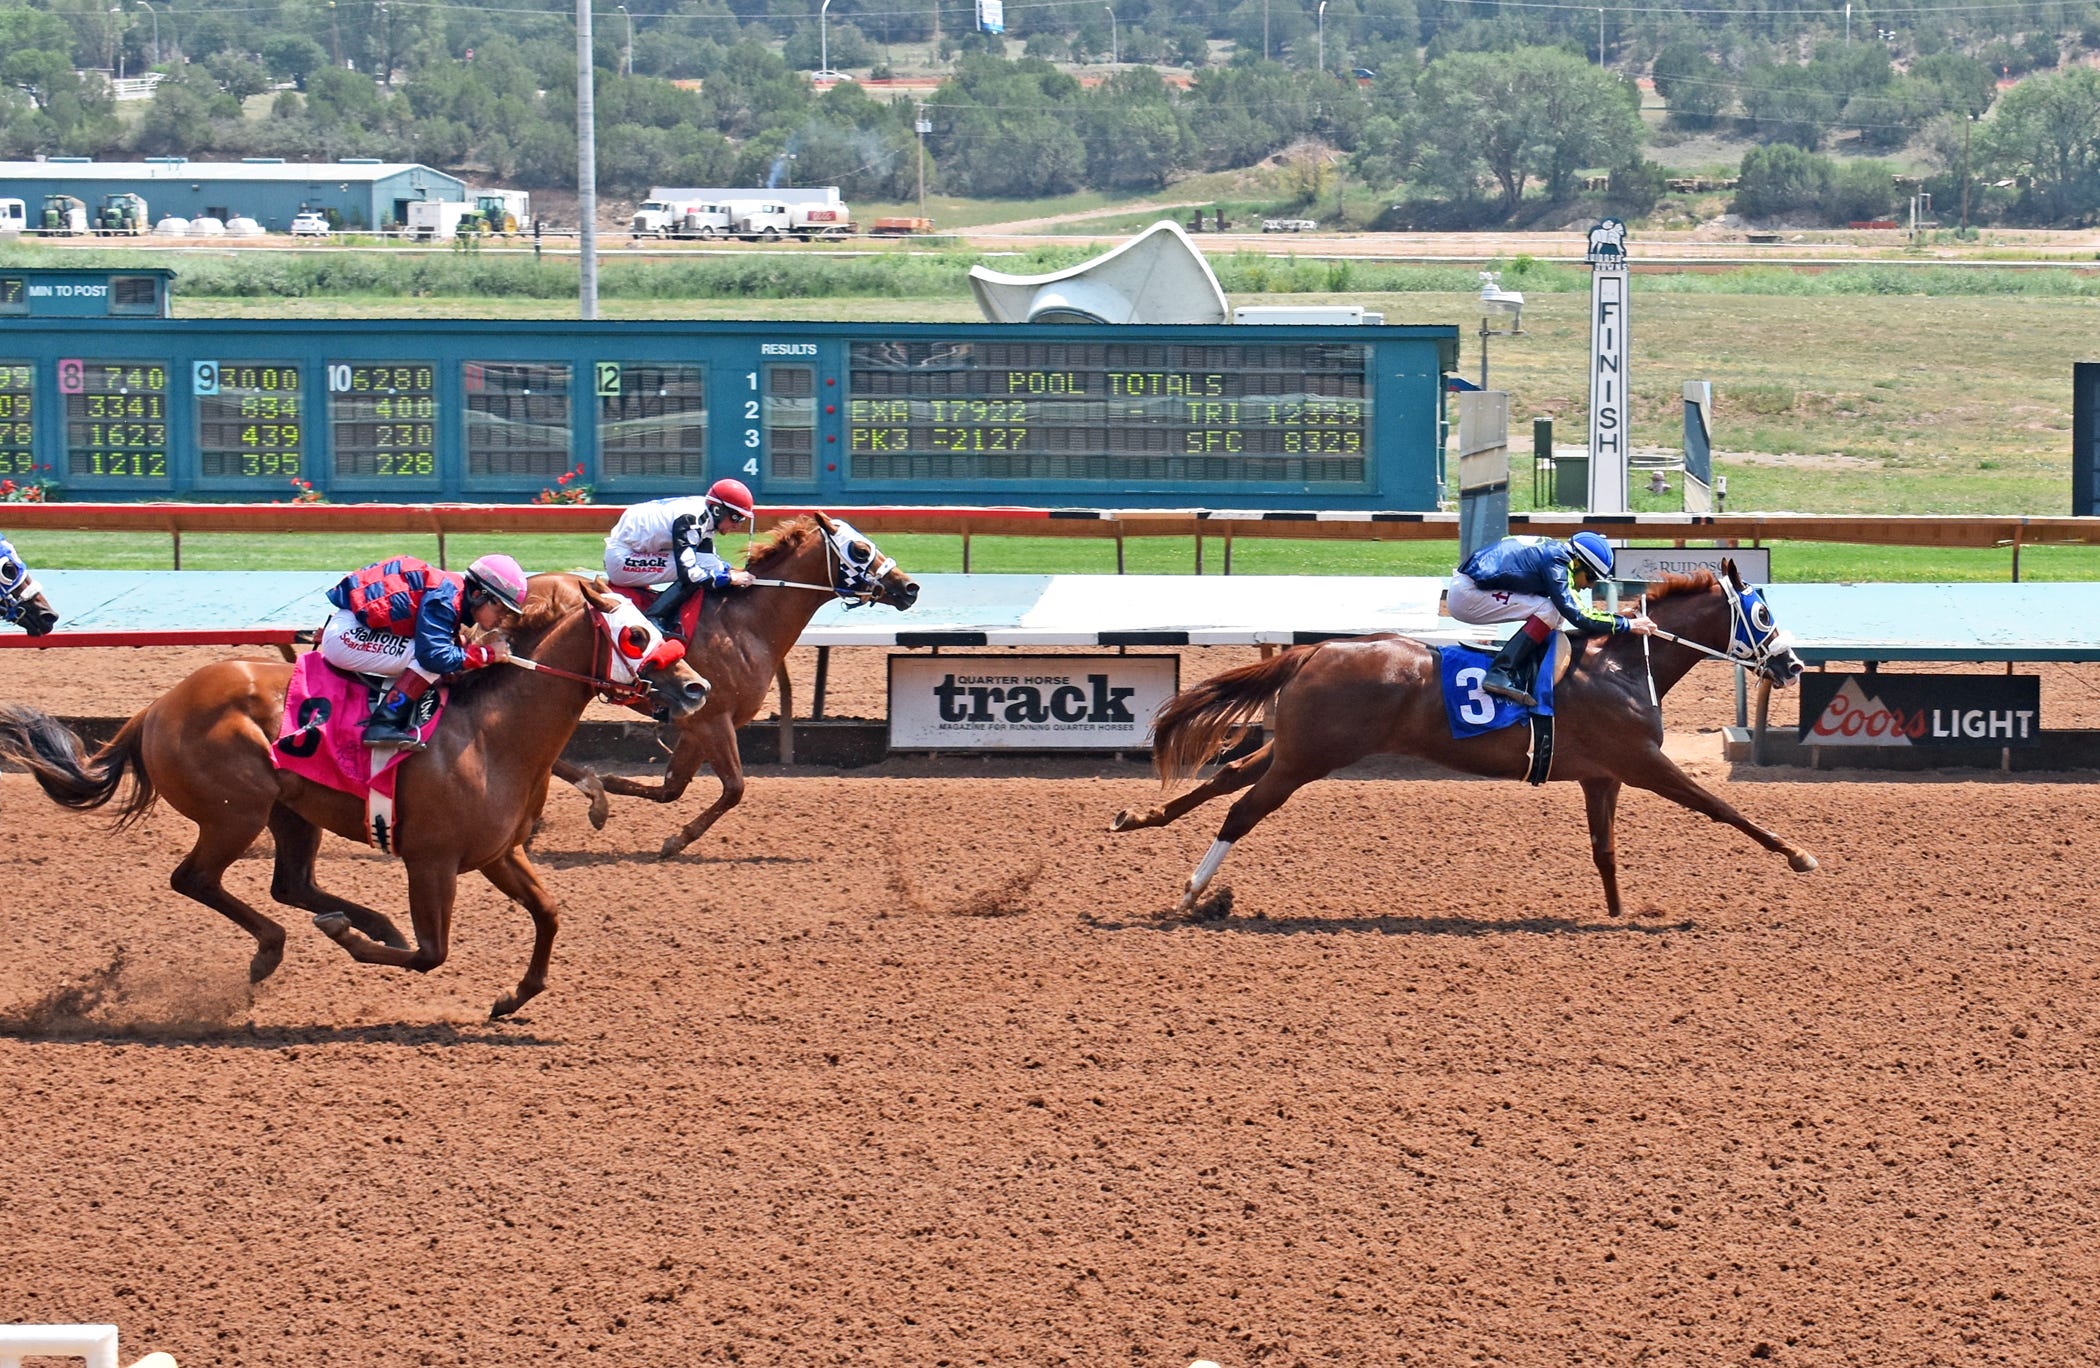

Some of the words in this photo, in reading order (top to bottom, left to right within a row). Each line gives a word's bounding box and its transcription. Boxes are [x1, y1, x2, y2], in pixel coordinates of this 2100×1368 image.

[6, 281, 21, 303] 7
[29, 285, 52, 296] MIN
[55, 285, 73, 296] TO
[74, 285, 108, 296] POST
[761, 343, 817, 355] RESULTS
[64, 363, 80, 389] 8
[105, 367, 164, 390] 740
[198, 364, 215, 391] 9
[219, 368, 297, 391] 3000
[328, 364, 352, 392] 10
[353, 368, 431, 391] 6280
[597, 366, 619, 392] 12
[746, 372, 757, 390] 1
[1009, 372, 1085, 395] POOL
[1107, 373, 1222, 396] TOTALS
[1600, 302, 1618, 453] FINISH
[88, 396, 161, 418] 3341
[241, 396, 298, 419] 834
[375, 397, 432, 419] 400
[744, 400, 760, 419] 2
[852, 400, 908, 422] EXA
[1186, 402, 1240, 424] TRI
[91, 424, 165, 446] 1623
[241, 425, 299, 447] 439
[376, 424, 432, 447] 230
[744, 429, 760, 448] 3
[852, 428, 909, 450] PK3
[1186, 430, 1242, 453] SFC
[1284, 431, 1360, 453] 8329
[92, 452, 165, 476] 1212
[242, 453, 299, 476] 395
[376, 452, 433, 475] 228
[742, 458, 759, 476] 4
[625, 557, 668, 567] track
[958, 676, 1019, 685] QUARTER
[1024, 676, 1070, 685] HORSE
[933, 674, 1135, 723] track
[1455, 667, 1496, 725] 3
[938, 723, 986, 731] MAGAZINE
[988, 723, 1006, 731] FOR
[1009, 723, 1050, 731] RUNNING
[1813, 694, 1927, 738] Coors
[1932, 709, 2034, 739] LIGHT
